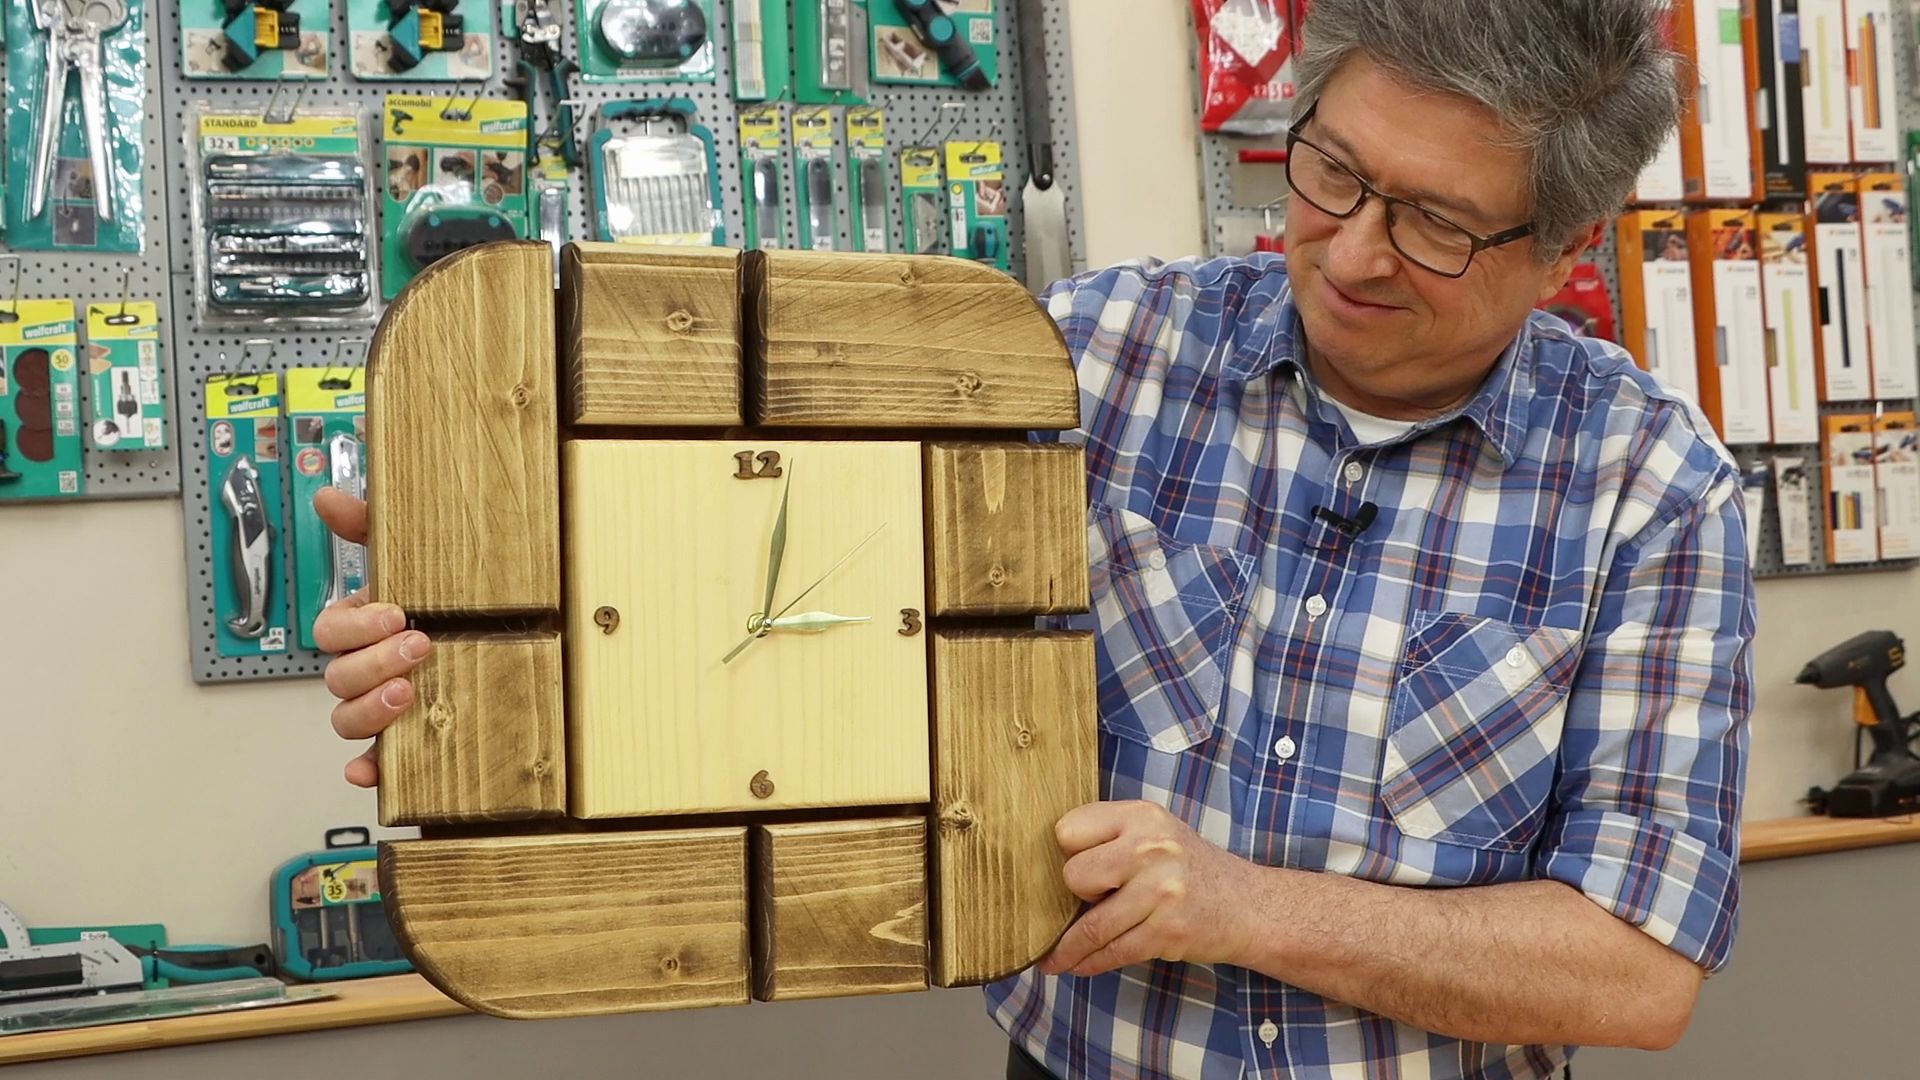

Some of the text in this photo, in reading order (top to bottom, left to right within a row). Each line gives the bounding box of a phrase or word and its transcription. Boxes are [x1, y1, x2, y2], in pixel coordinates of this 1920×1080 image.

[203, 118, 258, 128] STANDARD
[209, 137, 225, 149] 32
[24, 322, 67, 339] wolfcraft
[55, 354, 69, 364] 50
[229, 397, 271, 413] wolfcraft
[733, 450, 782, 480] 12
[593, 606, 620, 635] 9
[898, 608, 922, 637] 3
[750, 769, 775, 799] 6
[328, 885, 342, 896] 35
